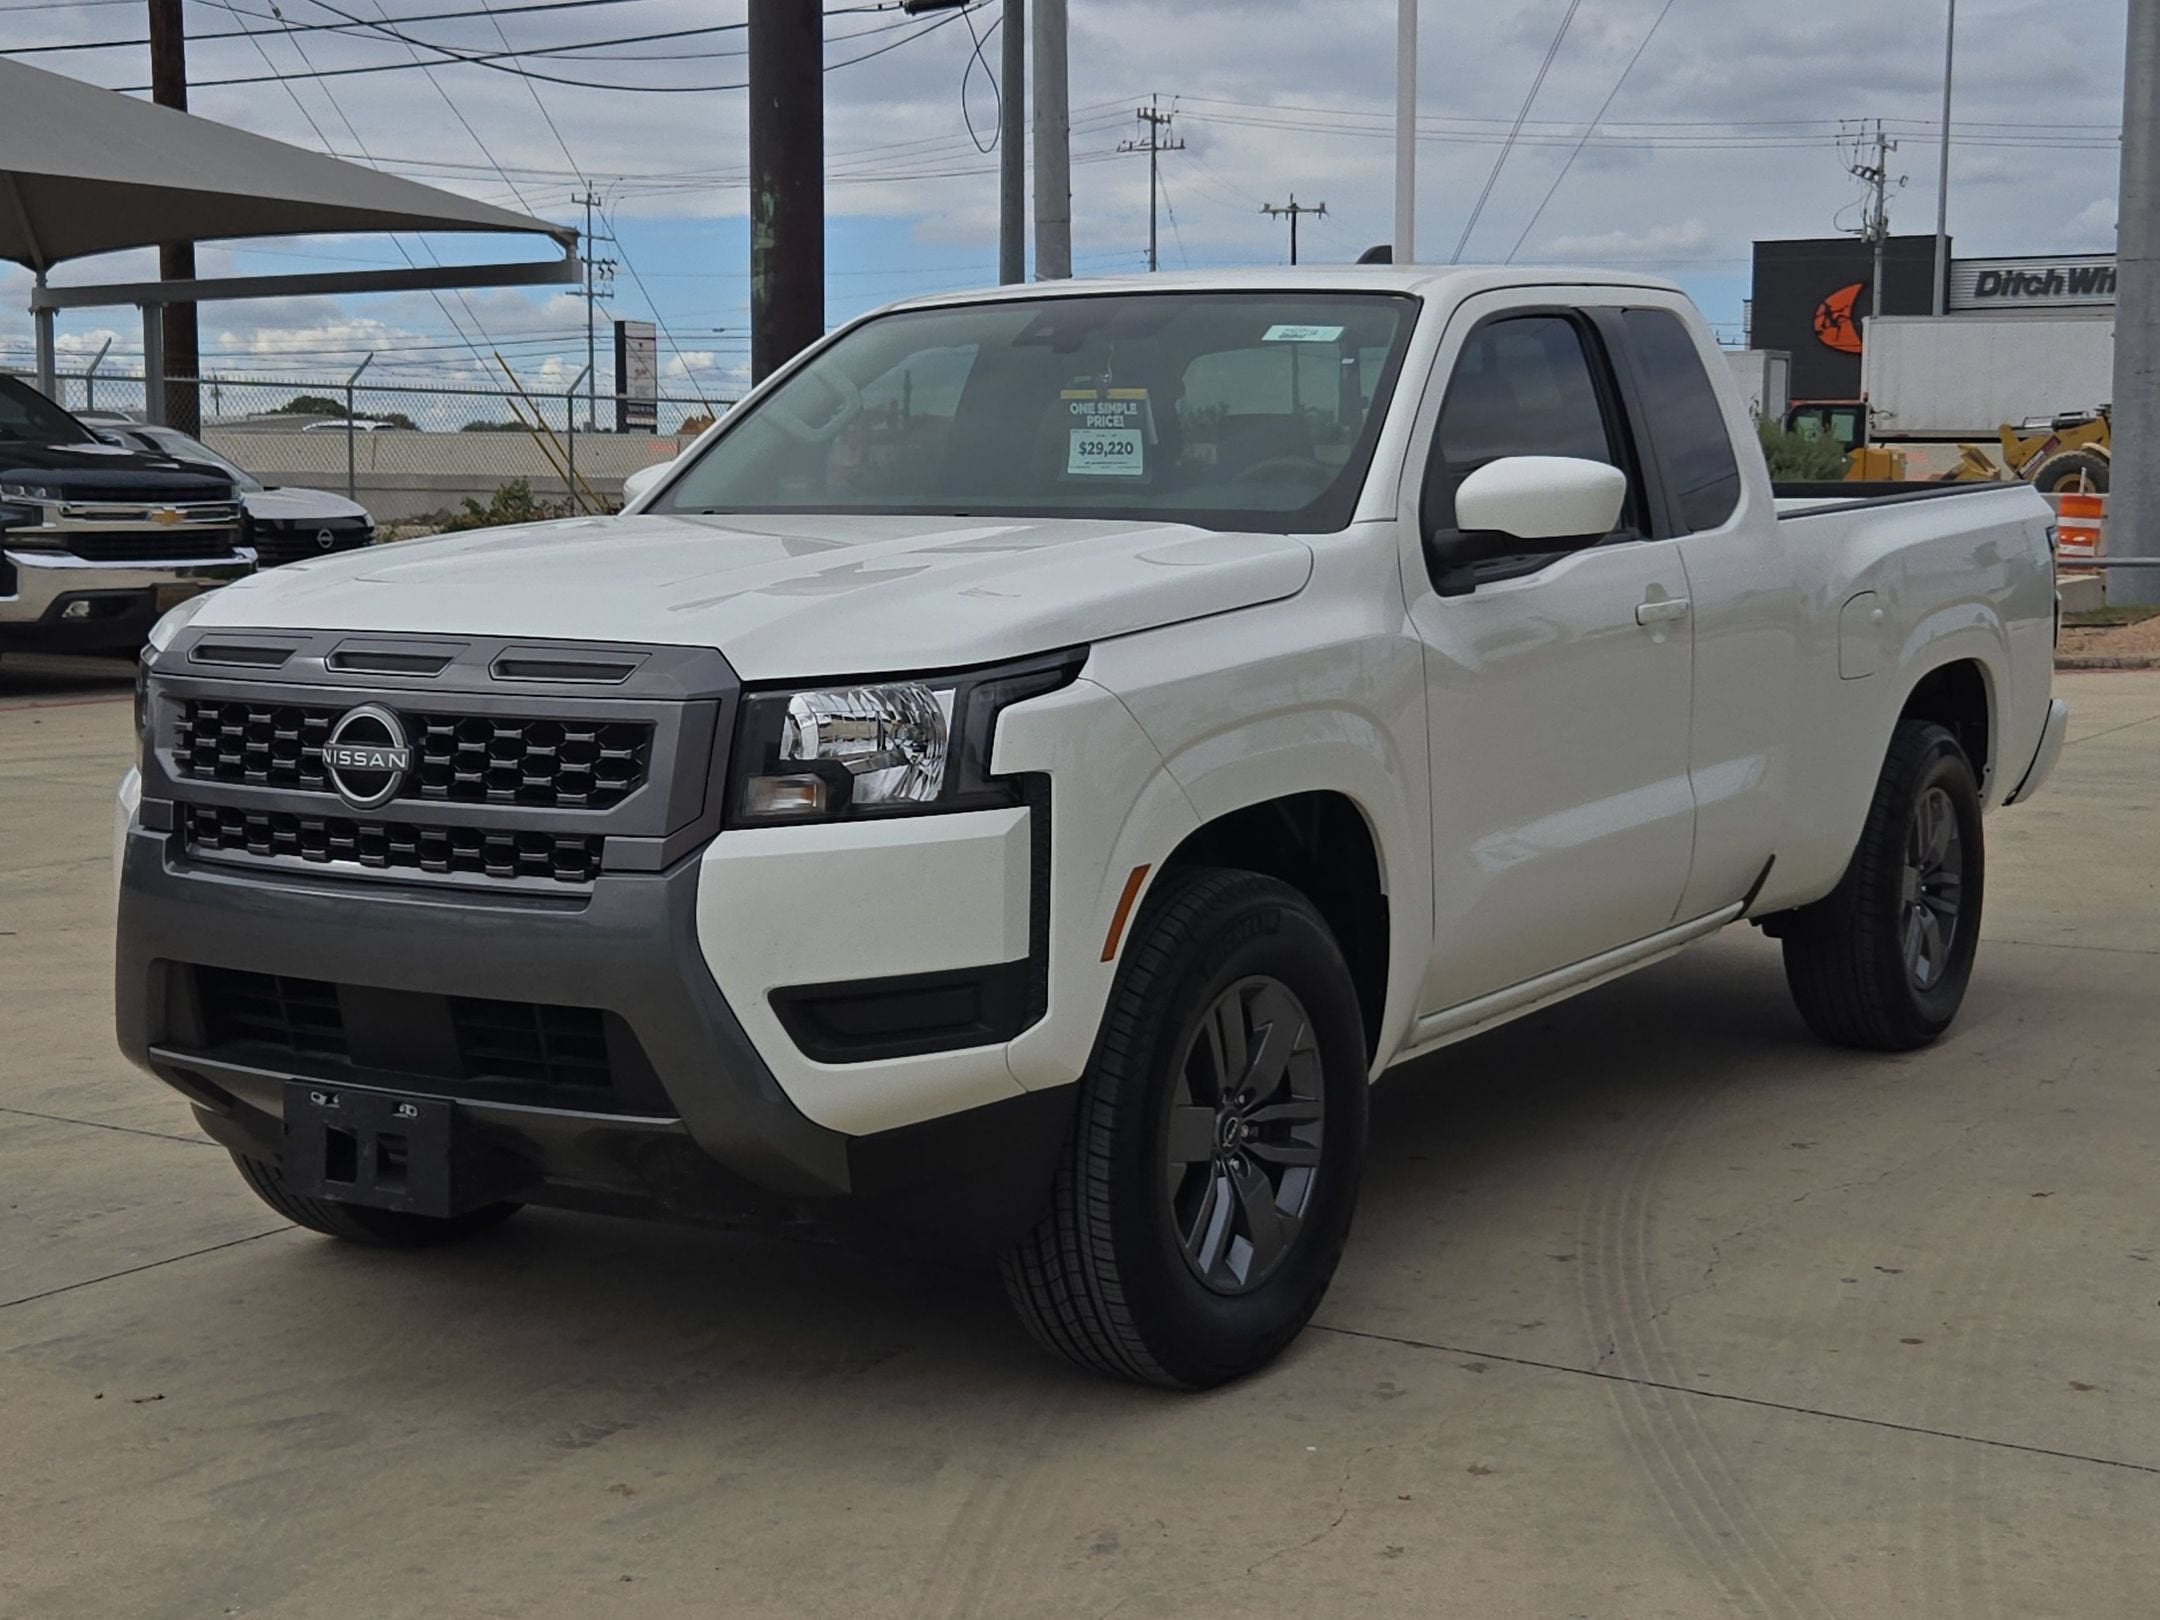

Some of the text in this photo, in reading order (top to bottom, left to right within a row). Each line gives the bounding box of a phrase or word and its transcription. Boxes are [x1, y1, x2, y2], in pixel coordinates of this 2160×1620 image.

[1974, 269, 2064, 297] Ditch
[1070, 402, 1137, 414] ONE SIMPLE
[1086, 415, 1124, 427] PRICE!
[1078, 441, 1133, 457] $29,220
[322, 748, 406, 768] NISSAN
